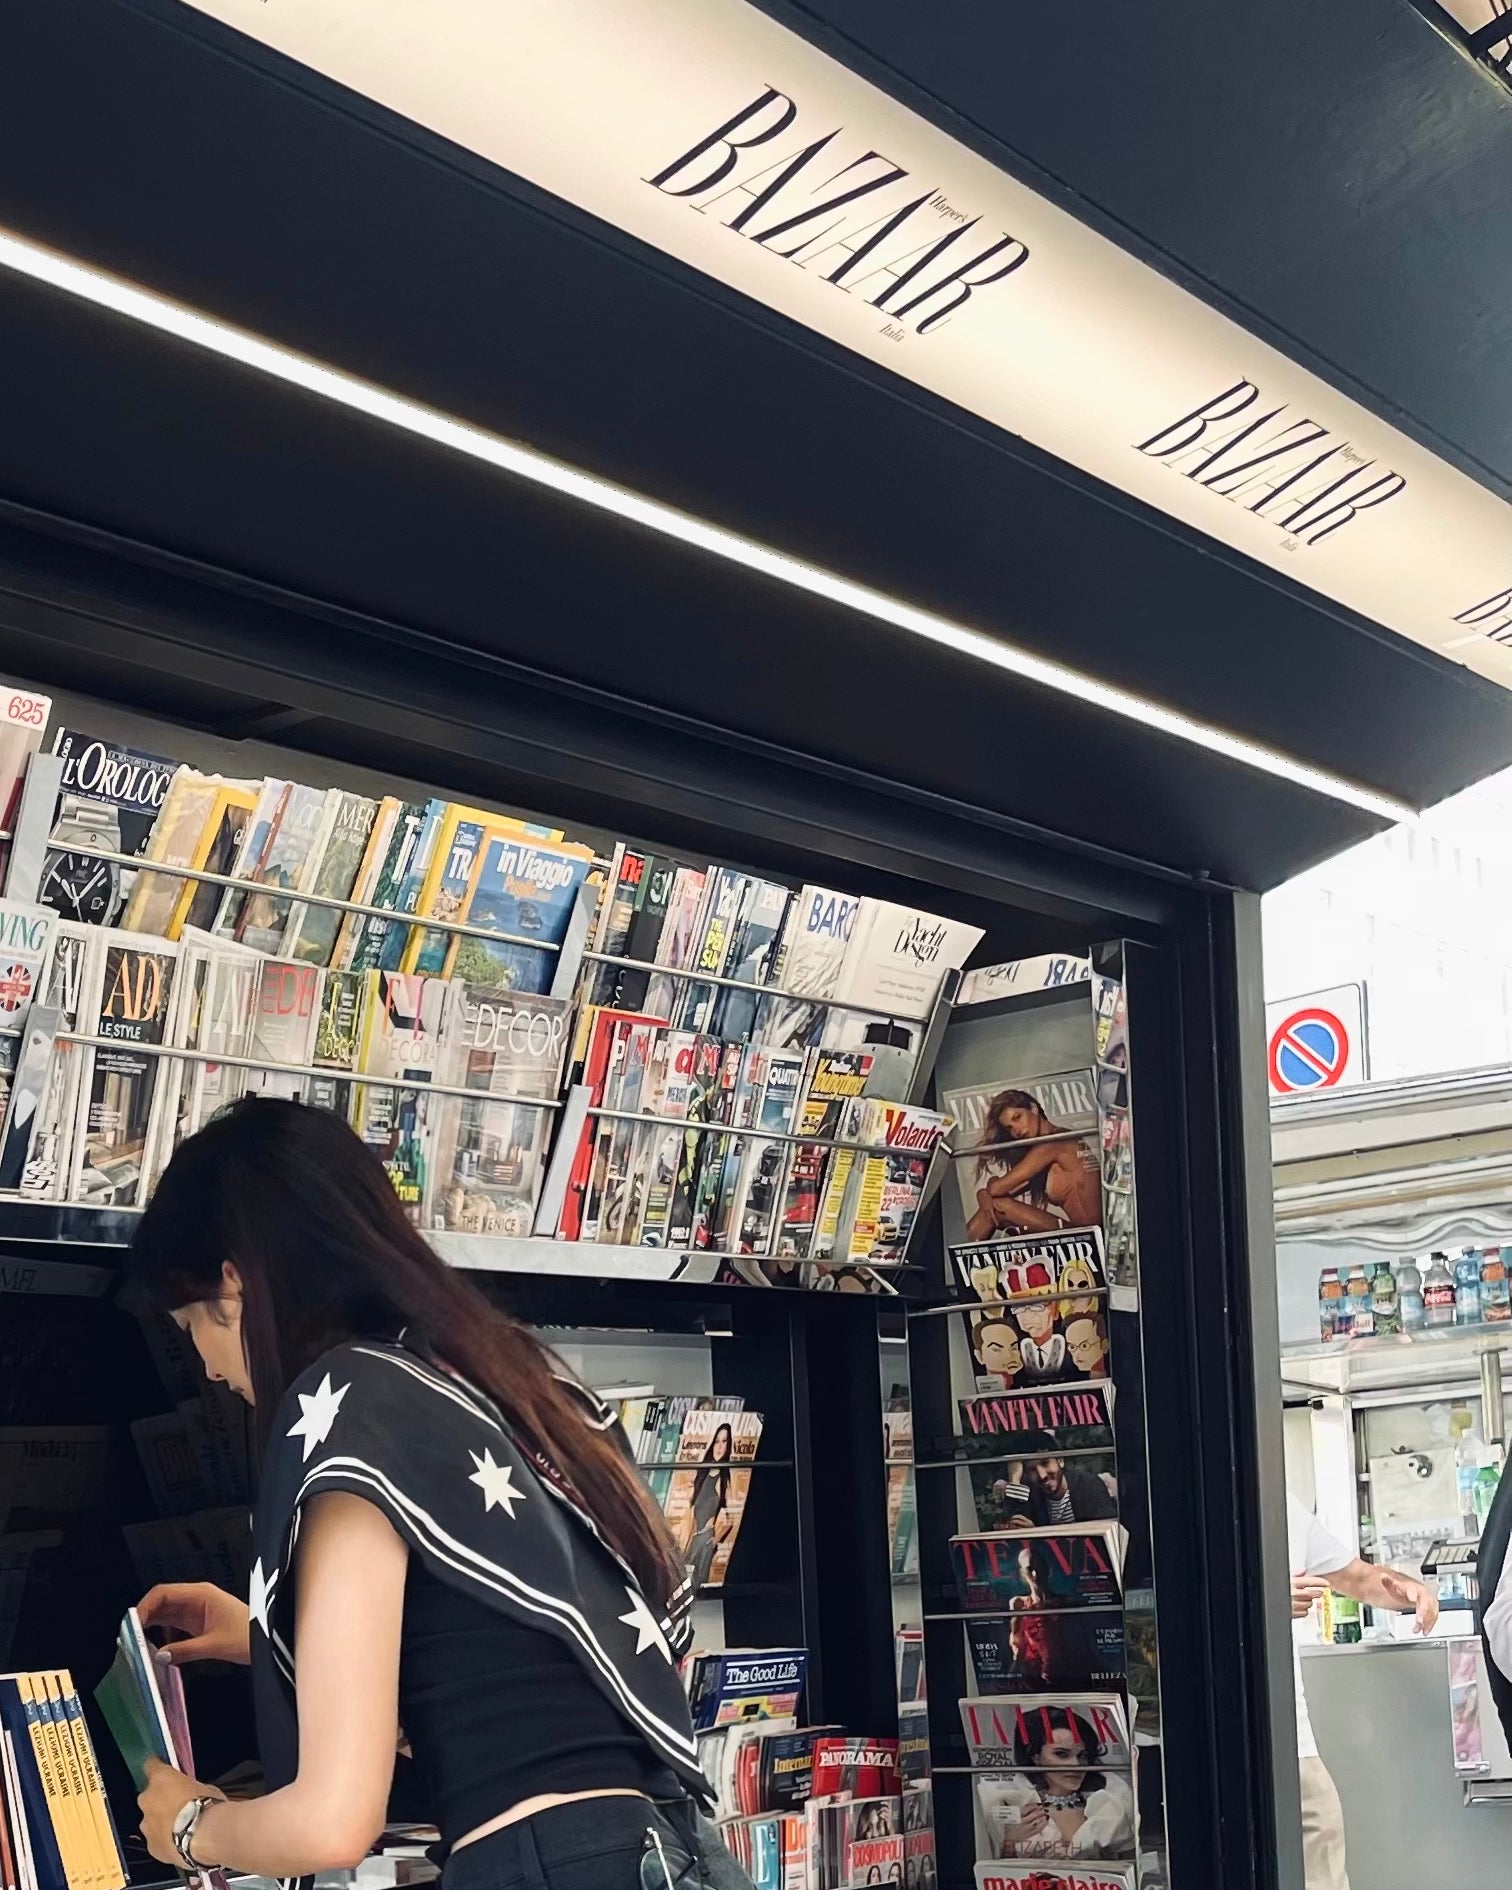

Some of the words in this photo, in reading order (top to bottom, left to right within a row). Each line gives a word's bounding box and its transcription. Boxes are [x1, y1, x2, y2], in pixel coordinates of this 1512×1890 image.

[640, 84, 1030, 335] BAZAAR
[1131, 375, 1407, 546] BAZAAR
[7, 695, 47, 725] 625
[894, 930, 940, 968] Design
[911, 918, 948, 947] Yacht
[102, 951, 163, 1023] AD
[99, 1021, 112, 1037] LE
[114, 1024, 141, 1040] STYLE
[474, 1003, 563, 1059] DECOR
[1037, 1081, 1094, 1116] FAIR
[462, 1215, 479, 1231] THE
[965, 1398, 1048, 1435] VANITY
[1048, 1393, 1104, 1428] FAIR
[953, 1537, 1112, 1581] TEVA
[725, 1667, 749, 1686] The
[749, 1664, 776, 1683] Good
[777, 1661, 800, 1680] Life
[818, 1751, 894, 1767] PANORAMA
